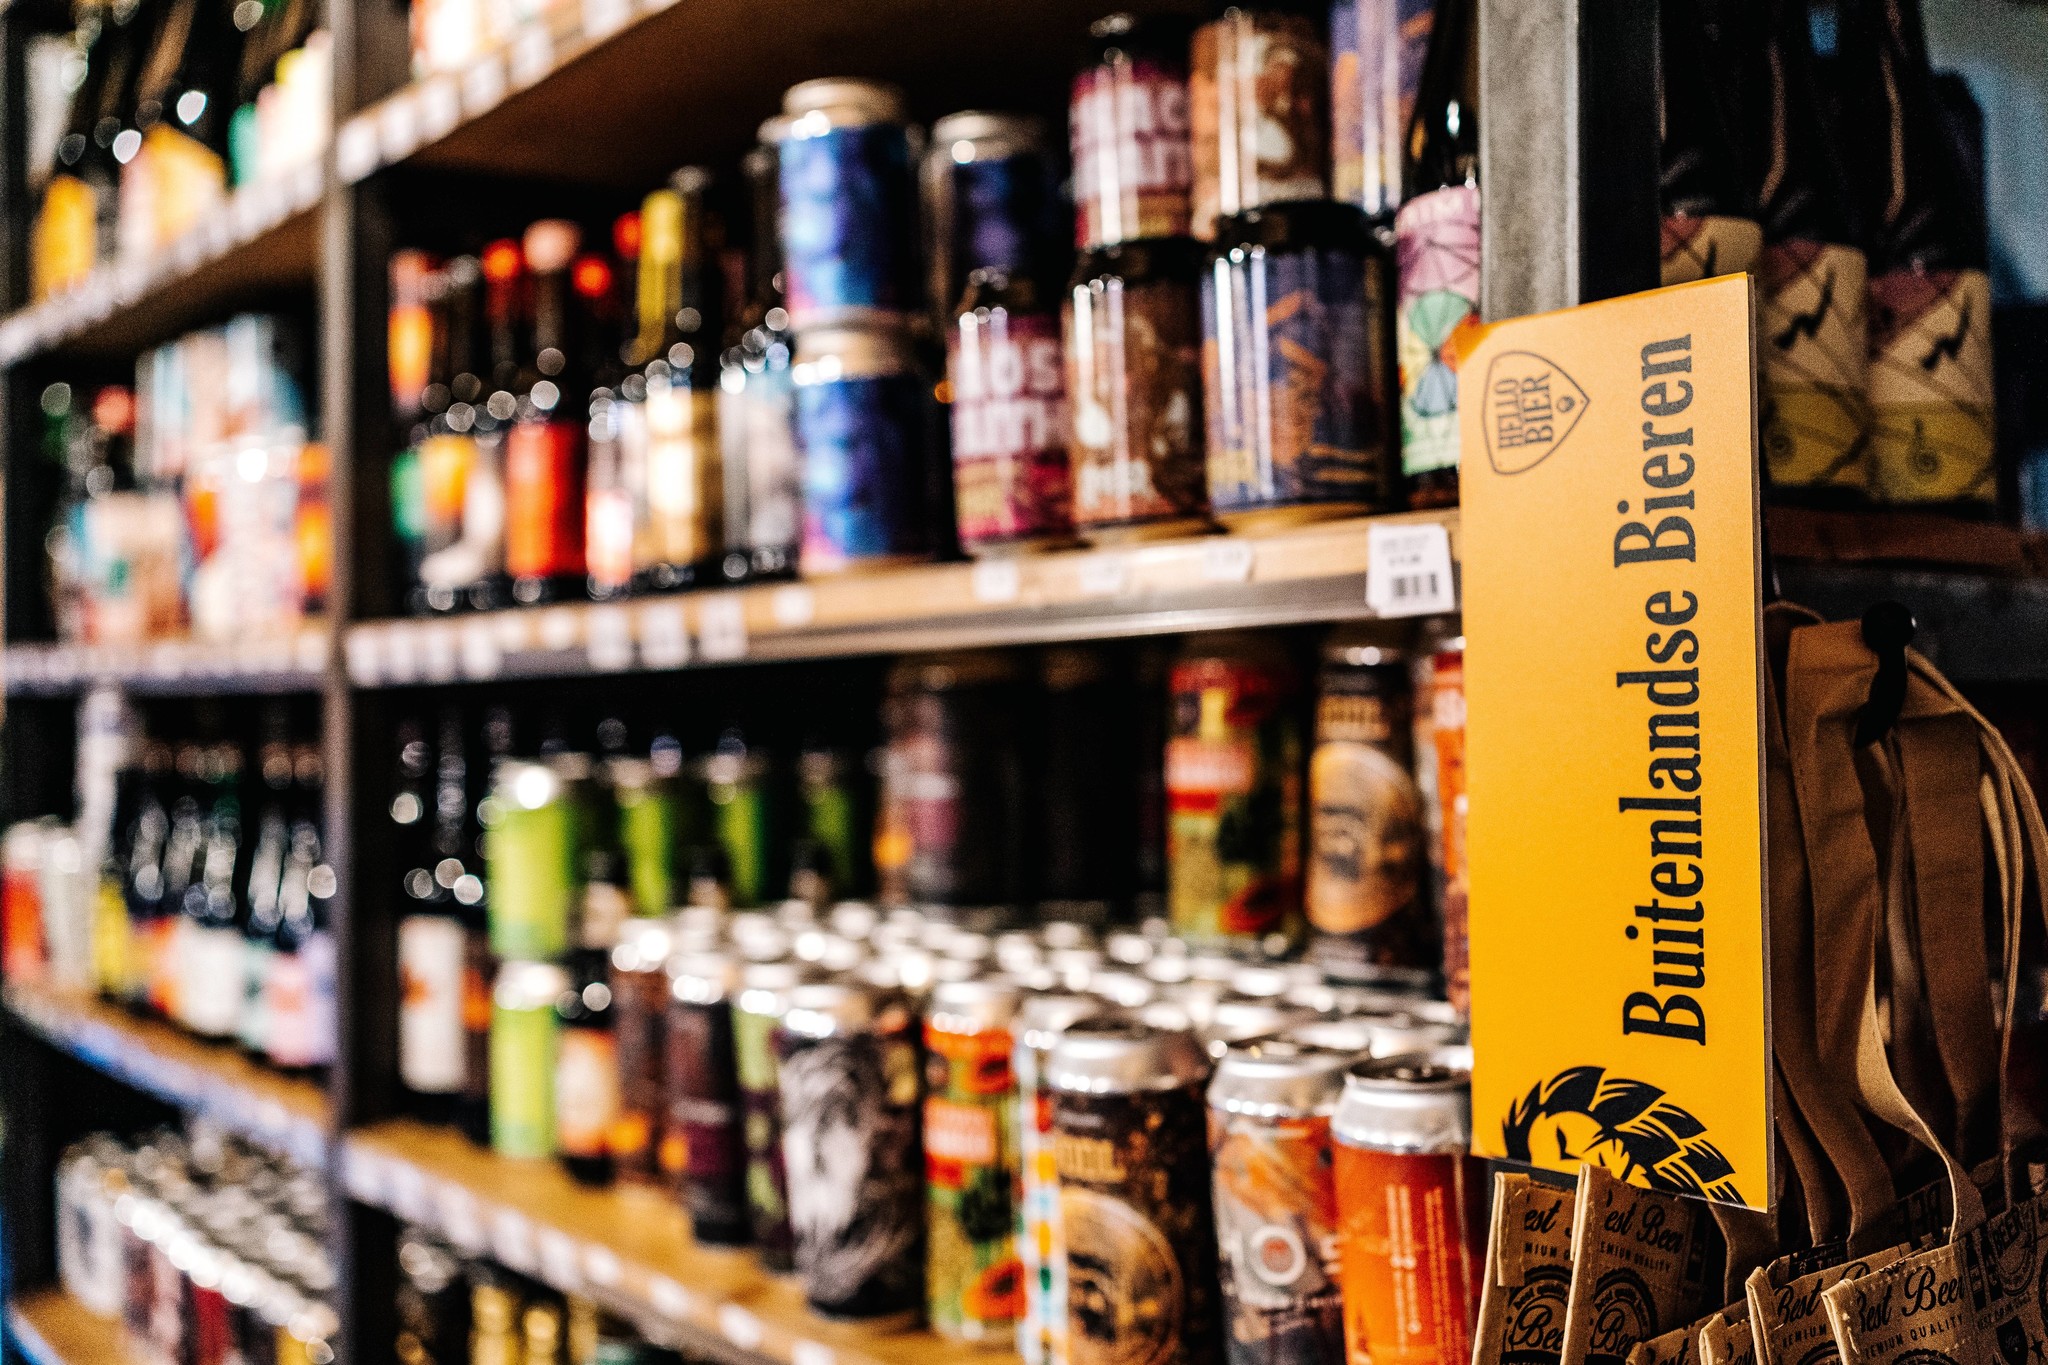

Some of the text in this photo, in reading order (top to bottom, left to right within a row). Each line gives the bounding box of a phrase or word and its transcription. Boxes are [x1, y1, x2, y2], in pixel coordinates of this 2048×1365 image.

[1494, 377, 1524, 449] HELLO
[1521, 370, 1553, 445] BIER
[1613, 333, 1706, 1047] Buitenlandse Bieren
[1524, 1192, 1563, 1234] est
[1604, 1188, 1684, 1254] est Beer
[1524, 1241, 1558, 1259] MIUM
[1600, 1240, 1671, 1272] EMIUM QUALITY
[1901, 1265, 1965, 1318] Beer
[1508, 1303, 1565, 1352] Bee
[1590, 1307, 1637, 1358] Bee
[1909, 1312, 1964, 1342] QUALITY
